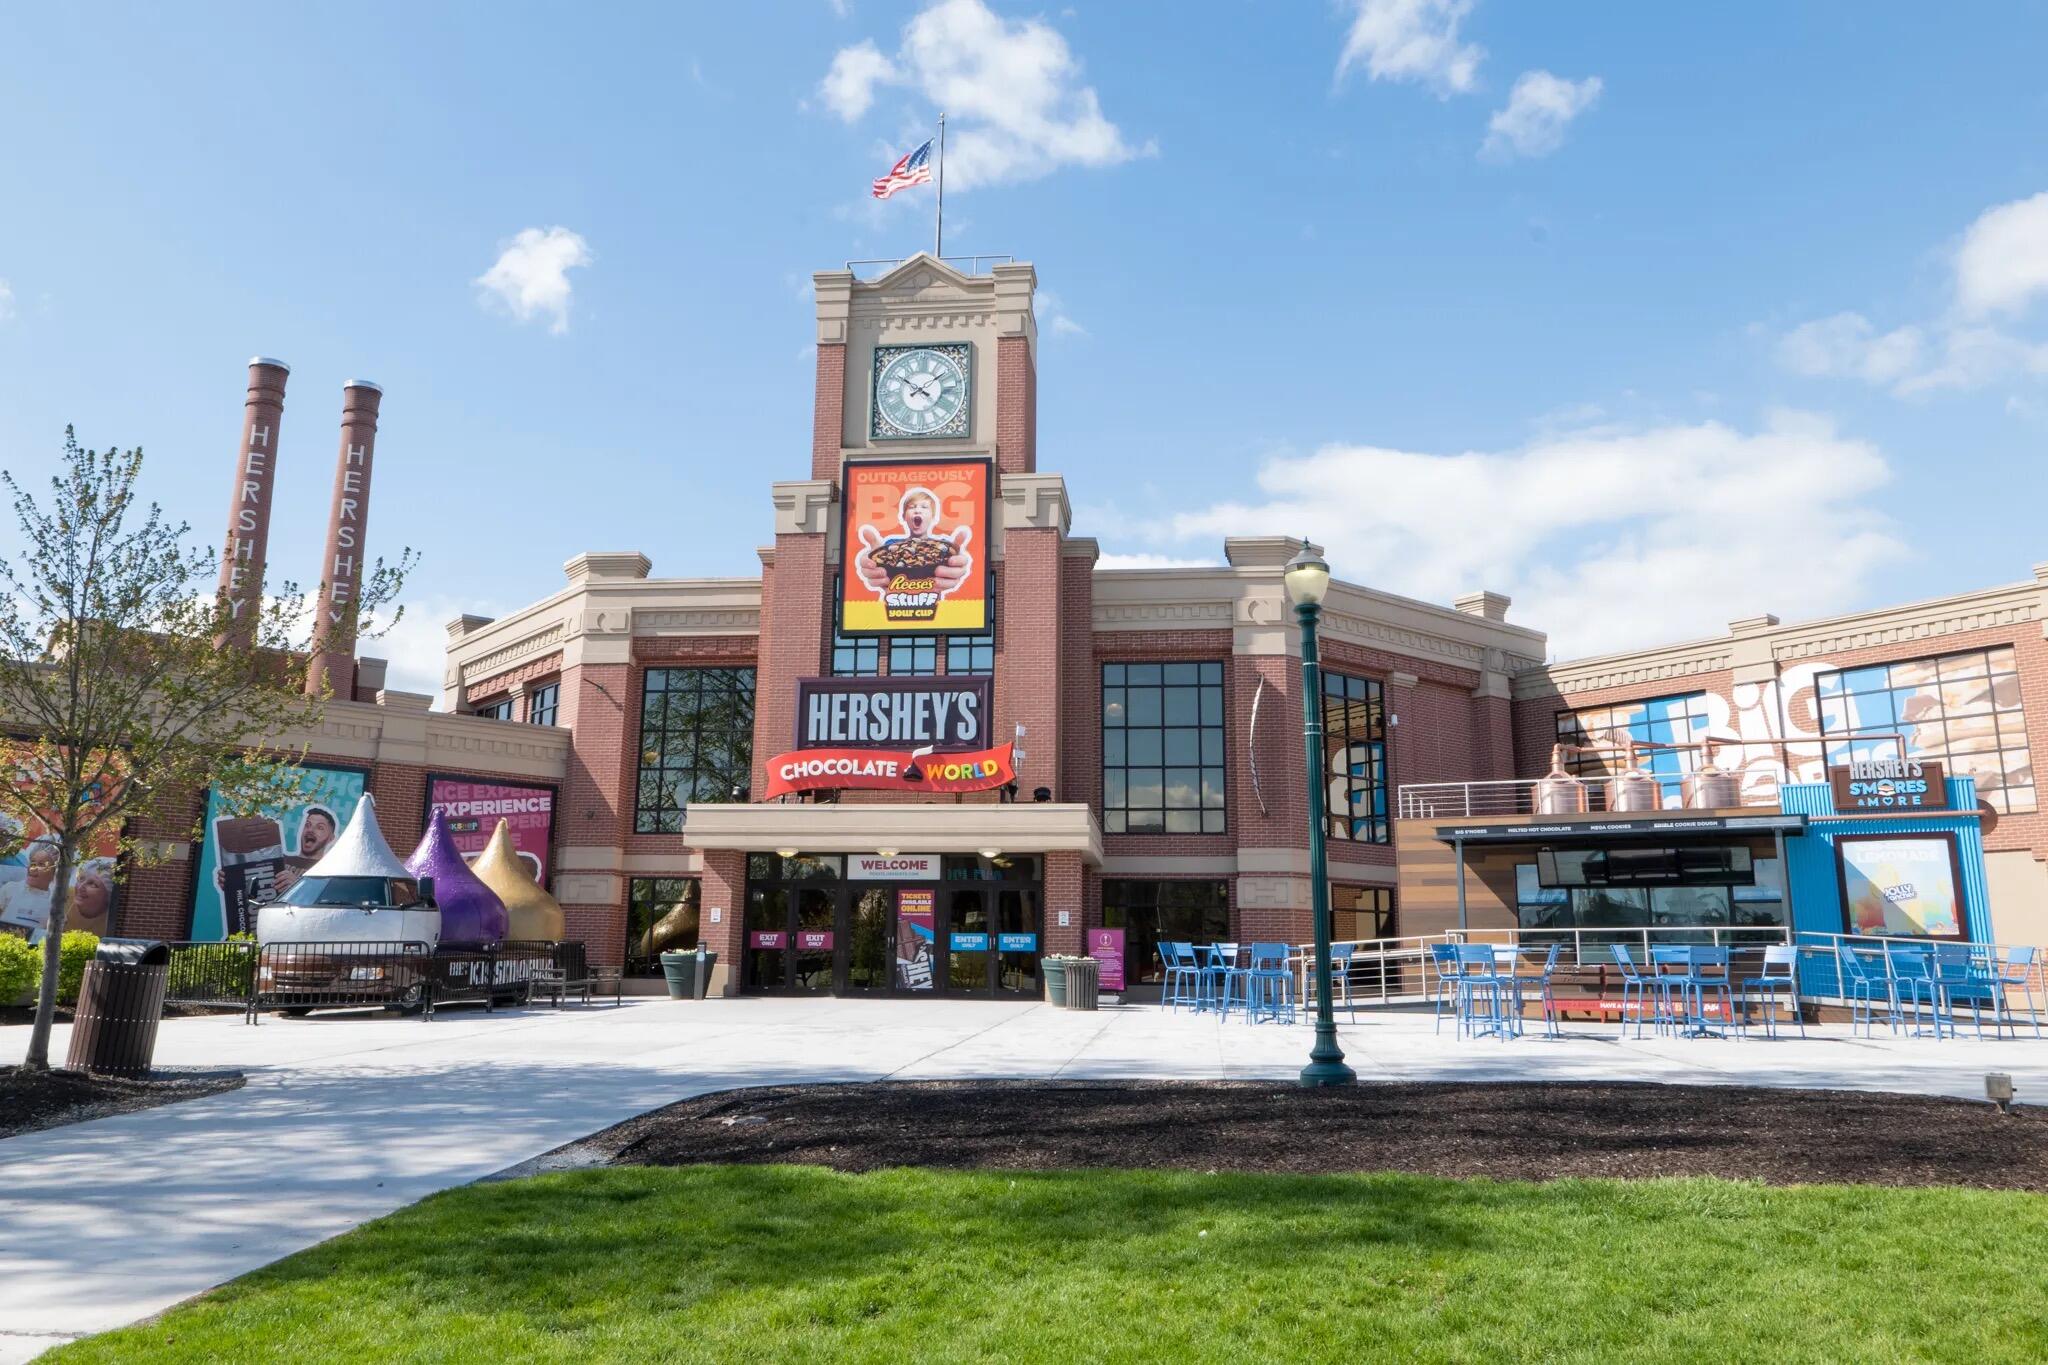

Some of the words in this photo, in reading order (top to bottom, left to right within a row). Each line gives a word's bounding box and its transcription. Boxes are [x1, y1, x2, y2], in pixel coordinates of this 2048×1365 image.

[857, 470, 975, 483] OUTRAGEOUSLY
[856, 482, 975, 532] BG
[229, 424, 269, 619] HERSHEY
[889, 575, 933, 590] Reese's
[808, 691, 977, 741] HERSHEY'S
[780, 758, 898, 781] CHOCOLATE
[926, 759, 999, 781] WORLD
[1850, 757, 1923, 780] HERSHEY'S
[1850, 779, 1928, 796] S'MORES
[861, 860, 928, 870] WELCOME
[1884, 884, 1912, 897] JOLLY
[759, 934, 778, 942] EXIT
[806, 934, 825, 942] EXIT
[1003, 936, 1031, 944] ENTER
